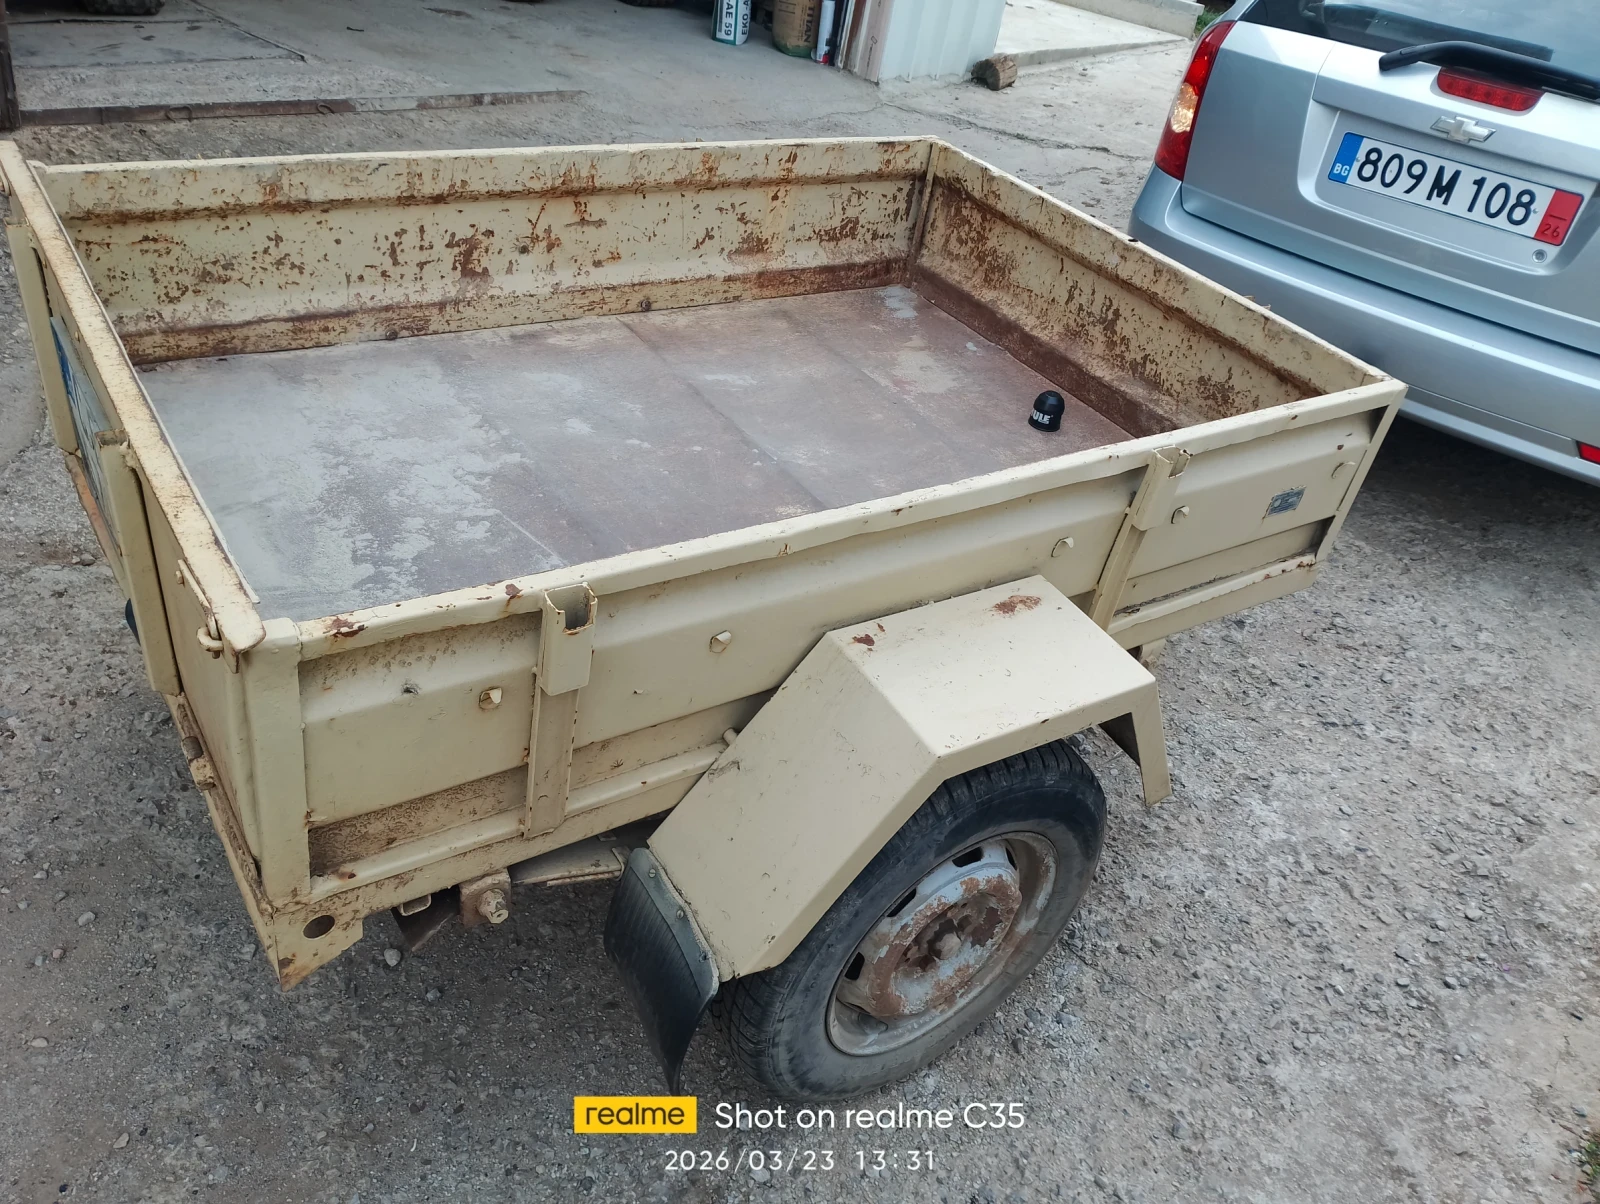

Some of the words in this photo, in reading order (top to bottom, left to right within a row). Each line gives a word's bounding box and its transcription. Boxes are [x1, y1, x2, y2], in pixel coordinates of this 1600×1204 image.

[724, 22, 733, 36] 59
[741, 13, 749, 36] EKO
[804, 6, 816, 43] TITAN
[1333, 163, 1350, 177] BG
[1357, 147, 1428, 194] 809
[1426, 165, 1462, 206] M
[1467, 176, 1536, 226] 108
[1541, 223, 1560, 238] 26
